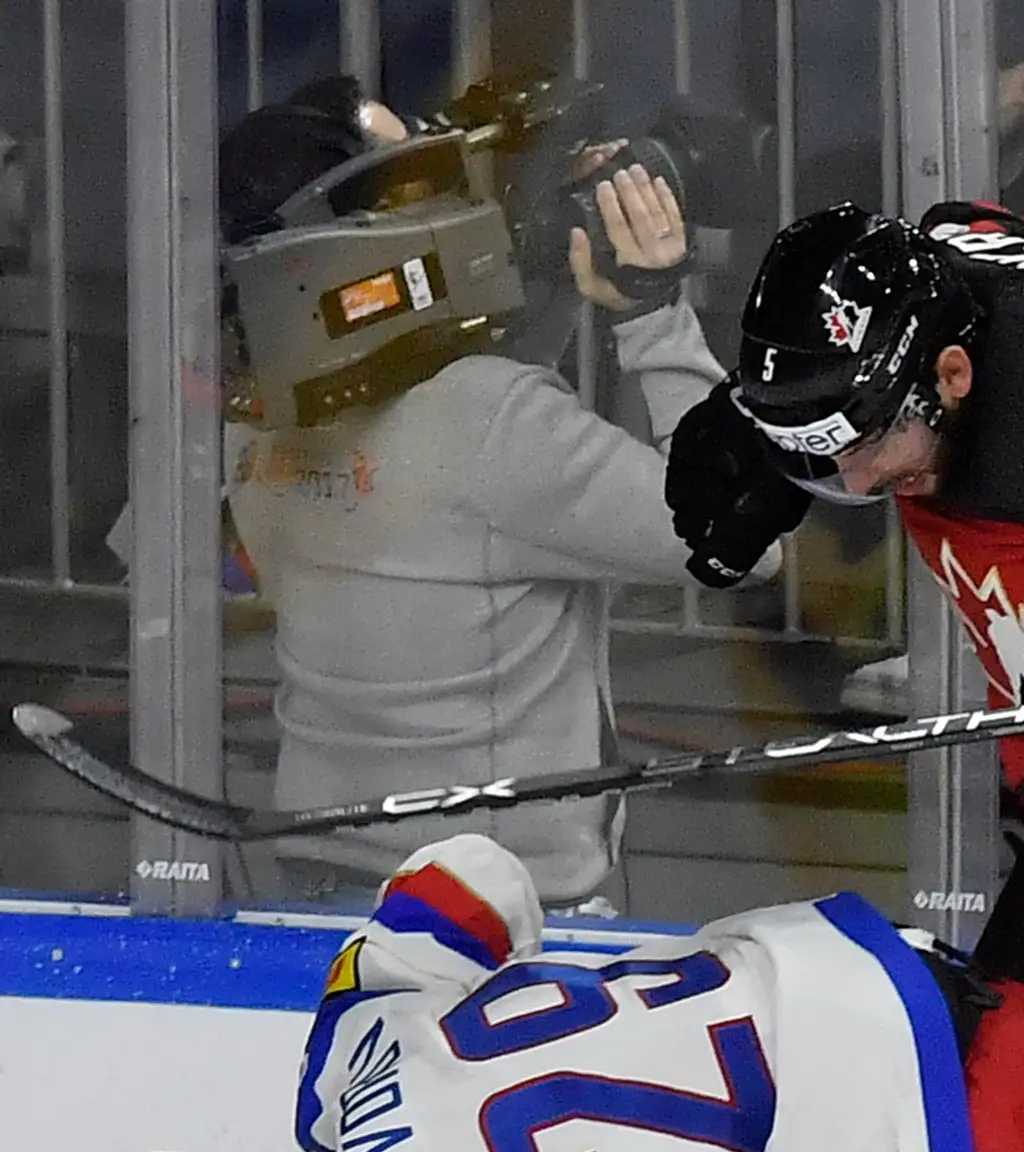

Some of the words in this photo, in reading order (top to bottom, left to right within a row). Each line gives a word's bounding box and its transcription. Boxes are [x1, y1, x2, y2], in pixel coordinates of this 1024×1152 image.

[761, 347, 778, 382] 5
[153, 860, 211, 882] RAITA
[929, 890, 986, 913] RAITA
